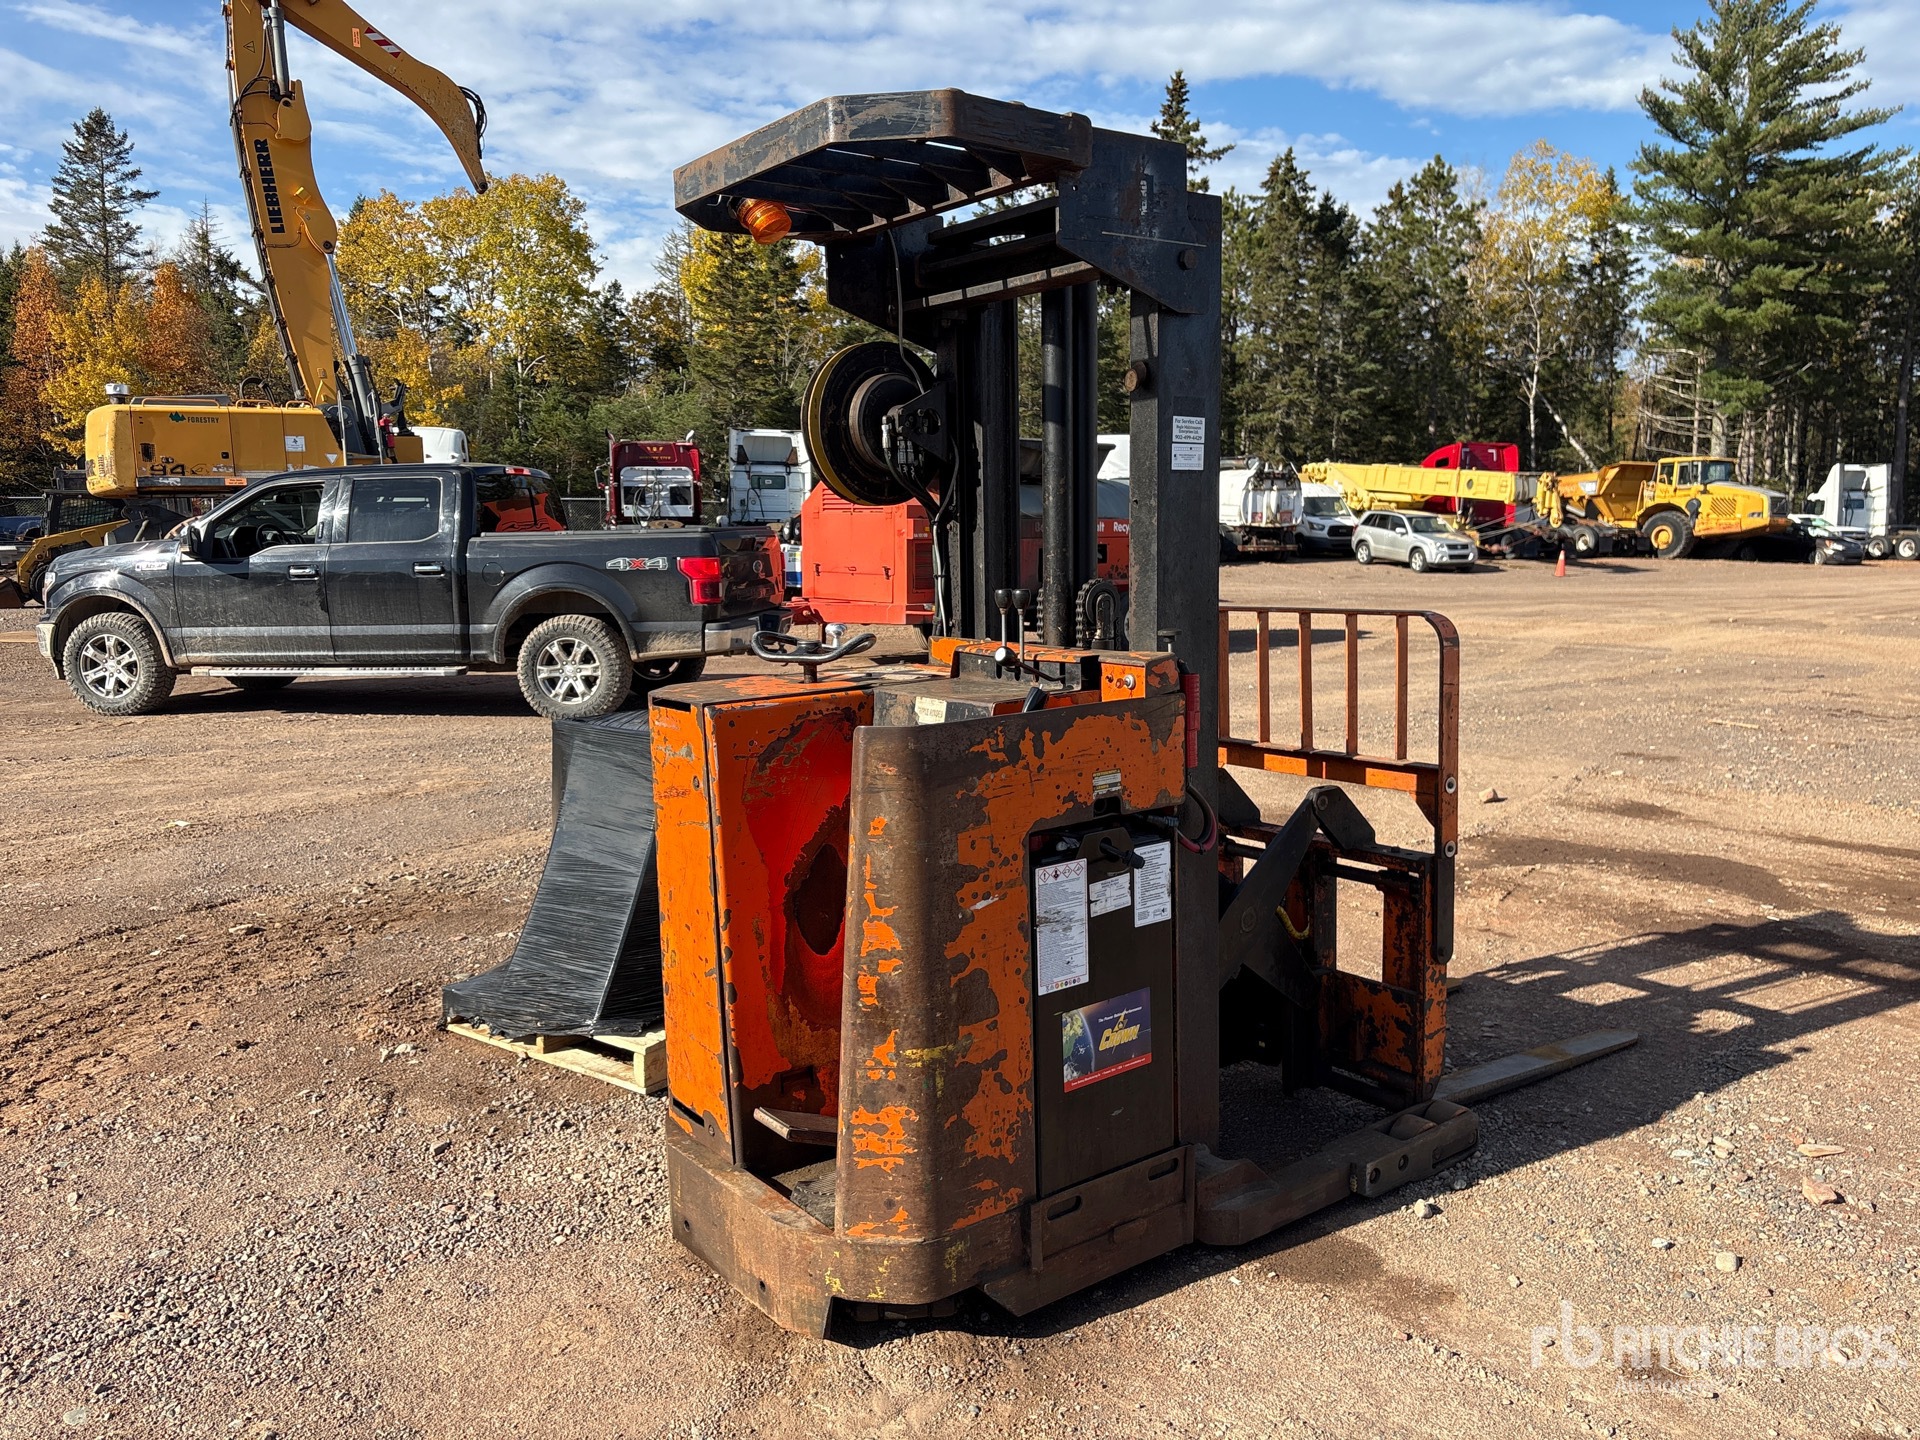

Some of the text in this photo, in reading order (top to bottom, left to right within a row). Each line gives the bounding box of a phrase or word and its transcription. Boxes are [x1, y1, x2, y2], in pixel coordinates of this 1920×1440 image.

[254, 138, 286, 234] LIEBHERR
[187, 416, 219, 424] FORESTRY
[1113, 521, 1130, 534] Recy
[1099, 1024, 1140, 1051] CROWN
